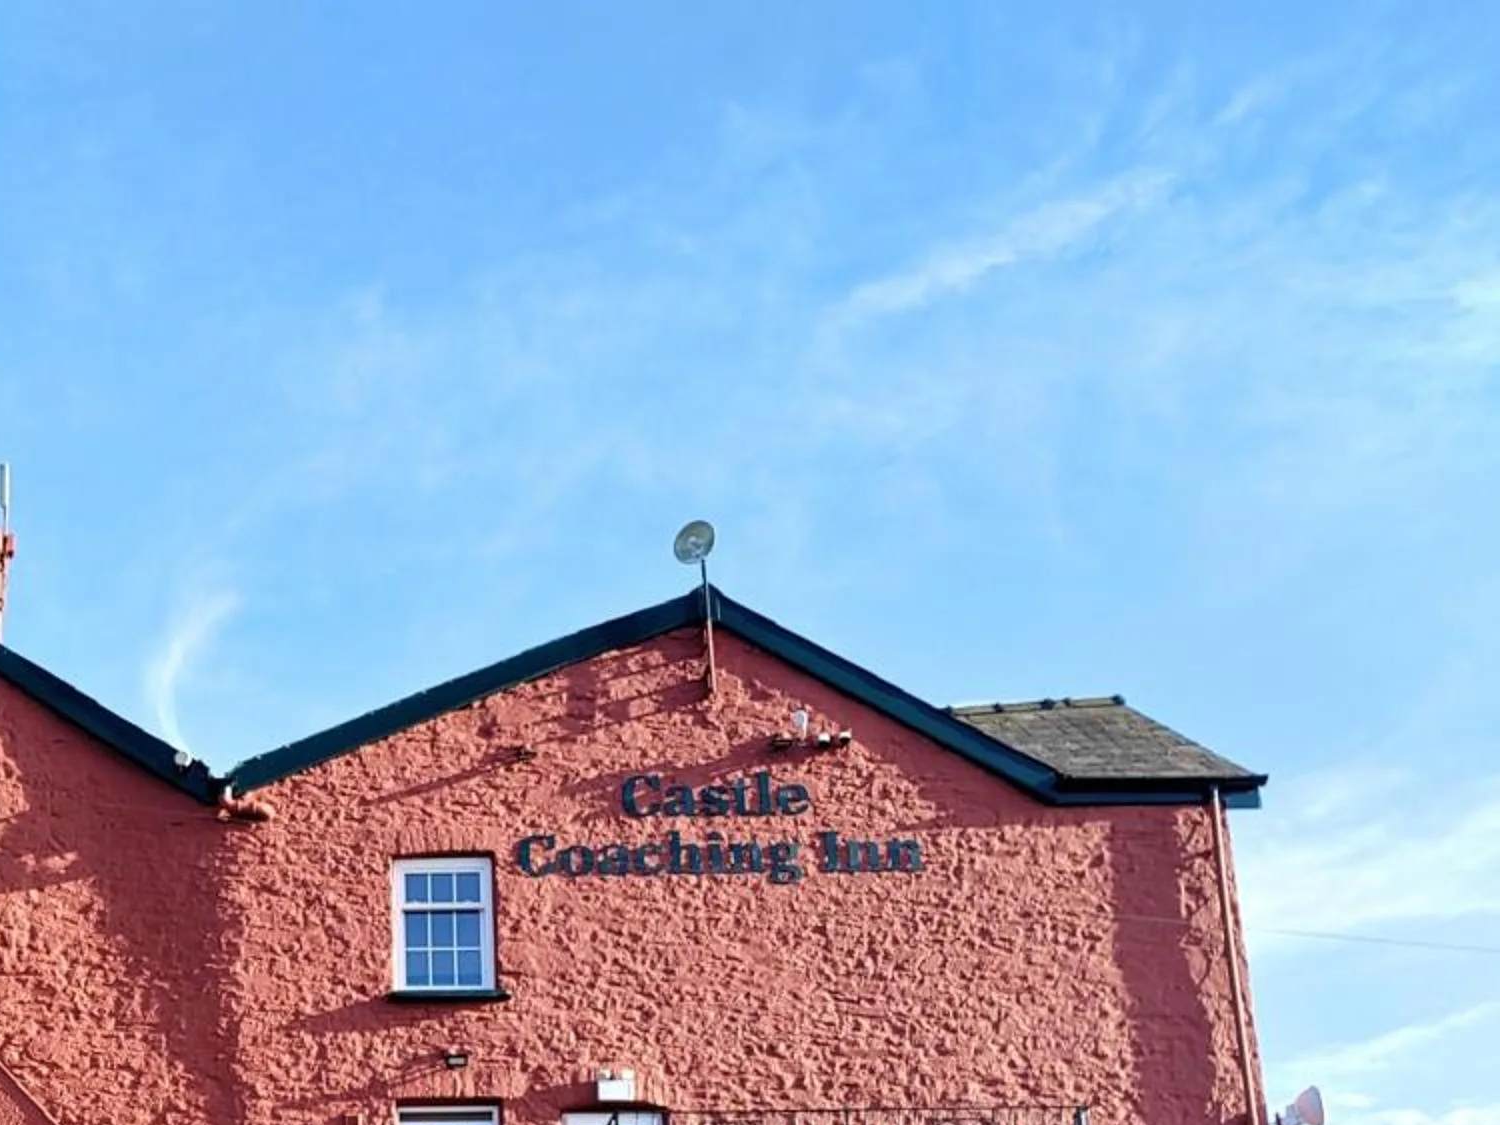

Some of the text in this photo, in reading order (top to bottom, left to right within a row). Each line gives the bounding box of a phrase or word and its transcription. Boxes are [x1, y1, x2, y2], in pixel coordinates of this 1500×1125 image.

[621, 770, 810, 818] Castle
[516, 830, 926, 885] Coaching Inn
